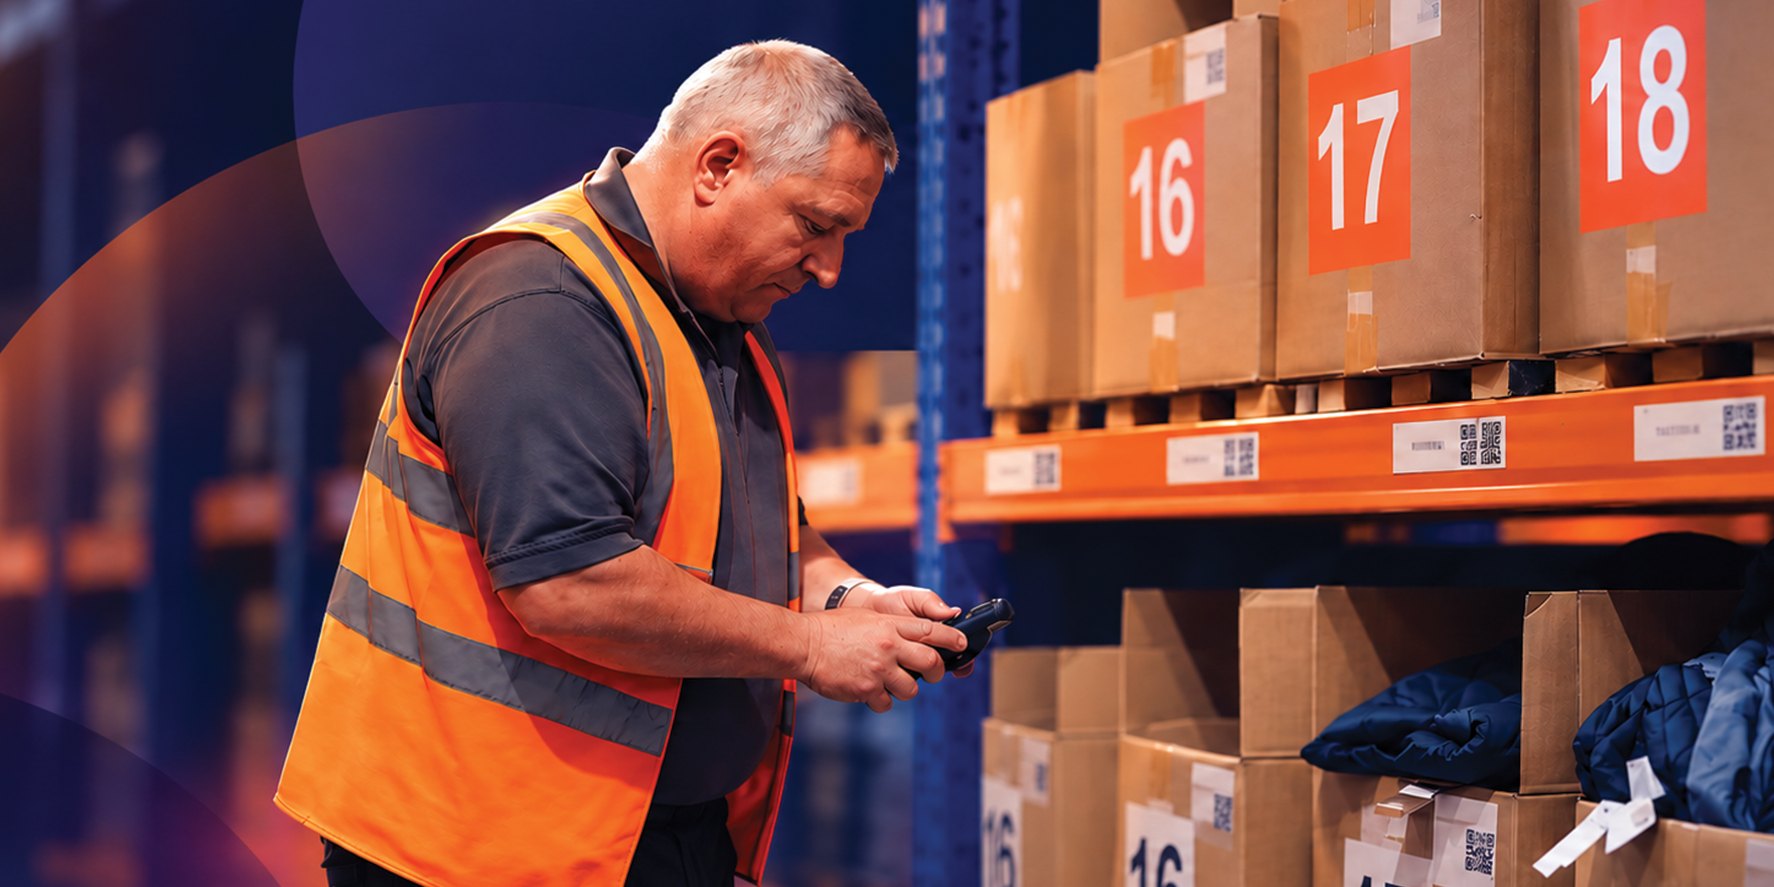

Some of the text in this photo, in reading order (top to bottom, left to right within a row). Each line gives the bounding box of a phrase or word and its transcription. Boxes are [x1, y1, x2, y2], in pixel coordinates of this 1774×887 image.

[1317, 89, 1399, 231] 17
[1590, 24, 1690, 183] 18
[1129, 137, 1195, 261] 16
